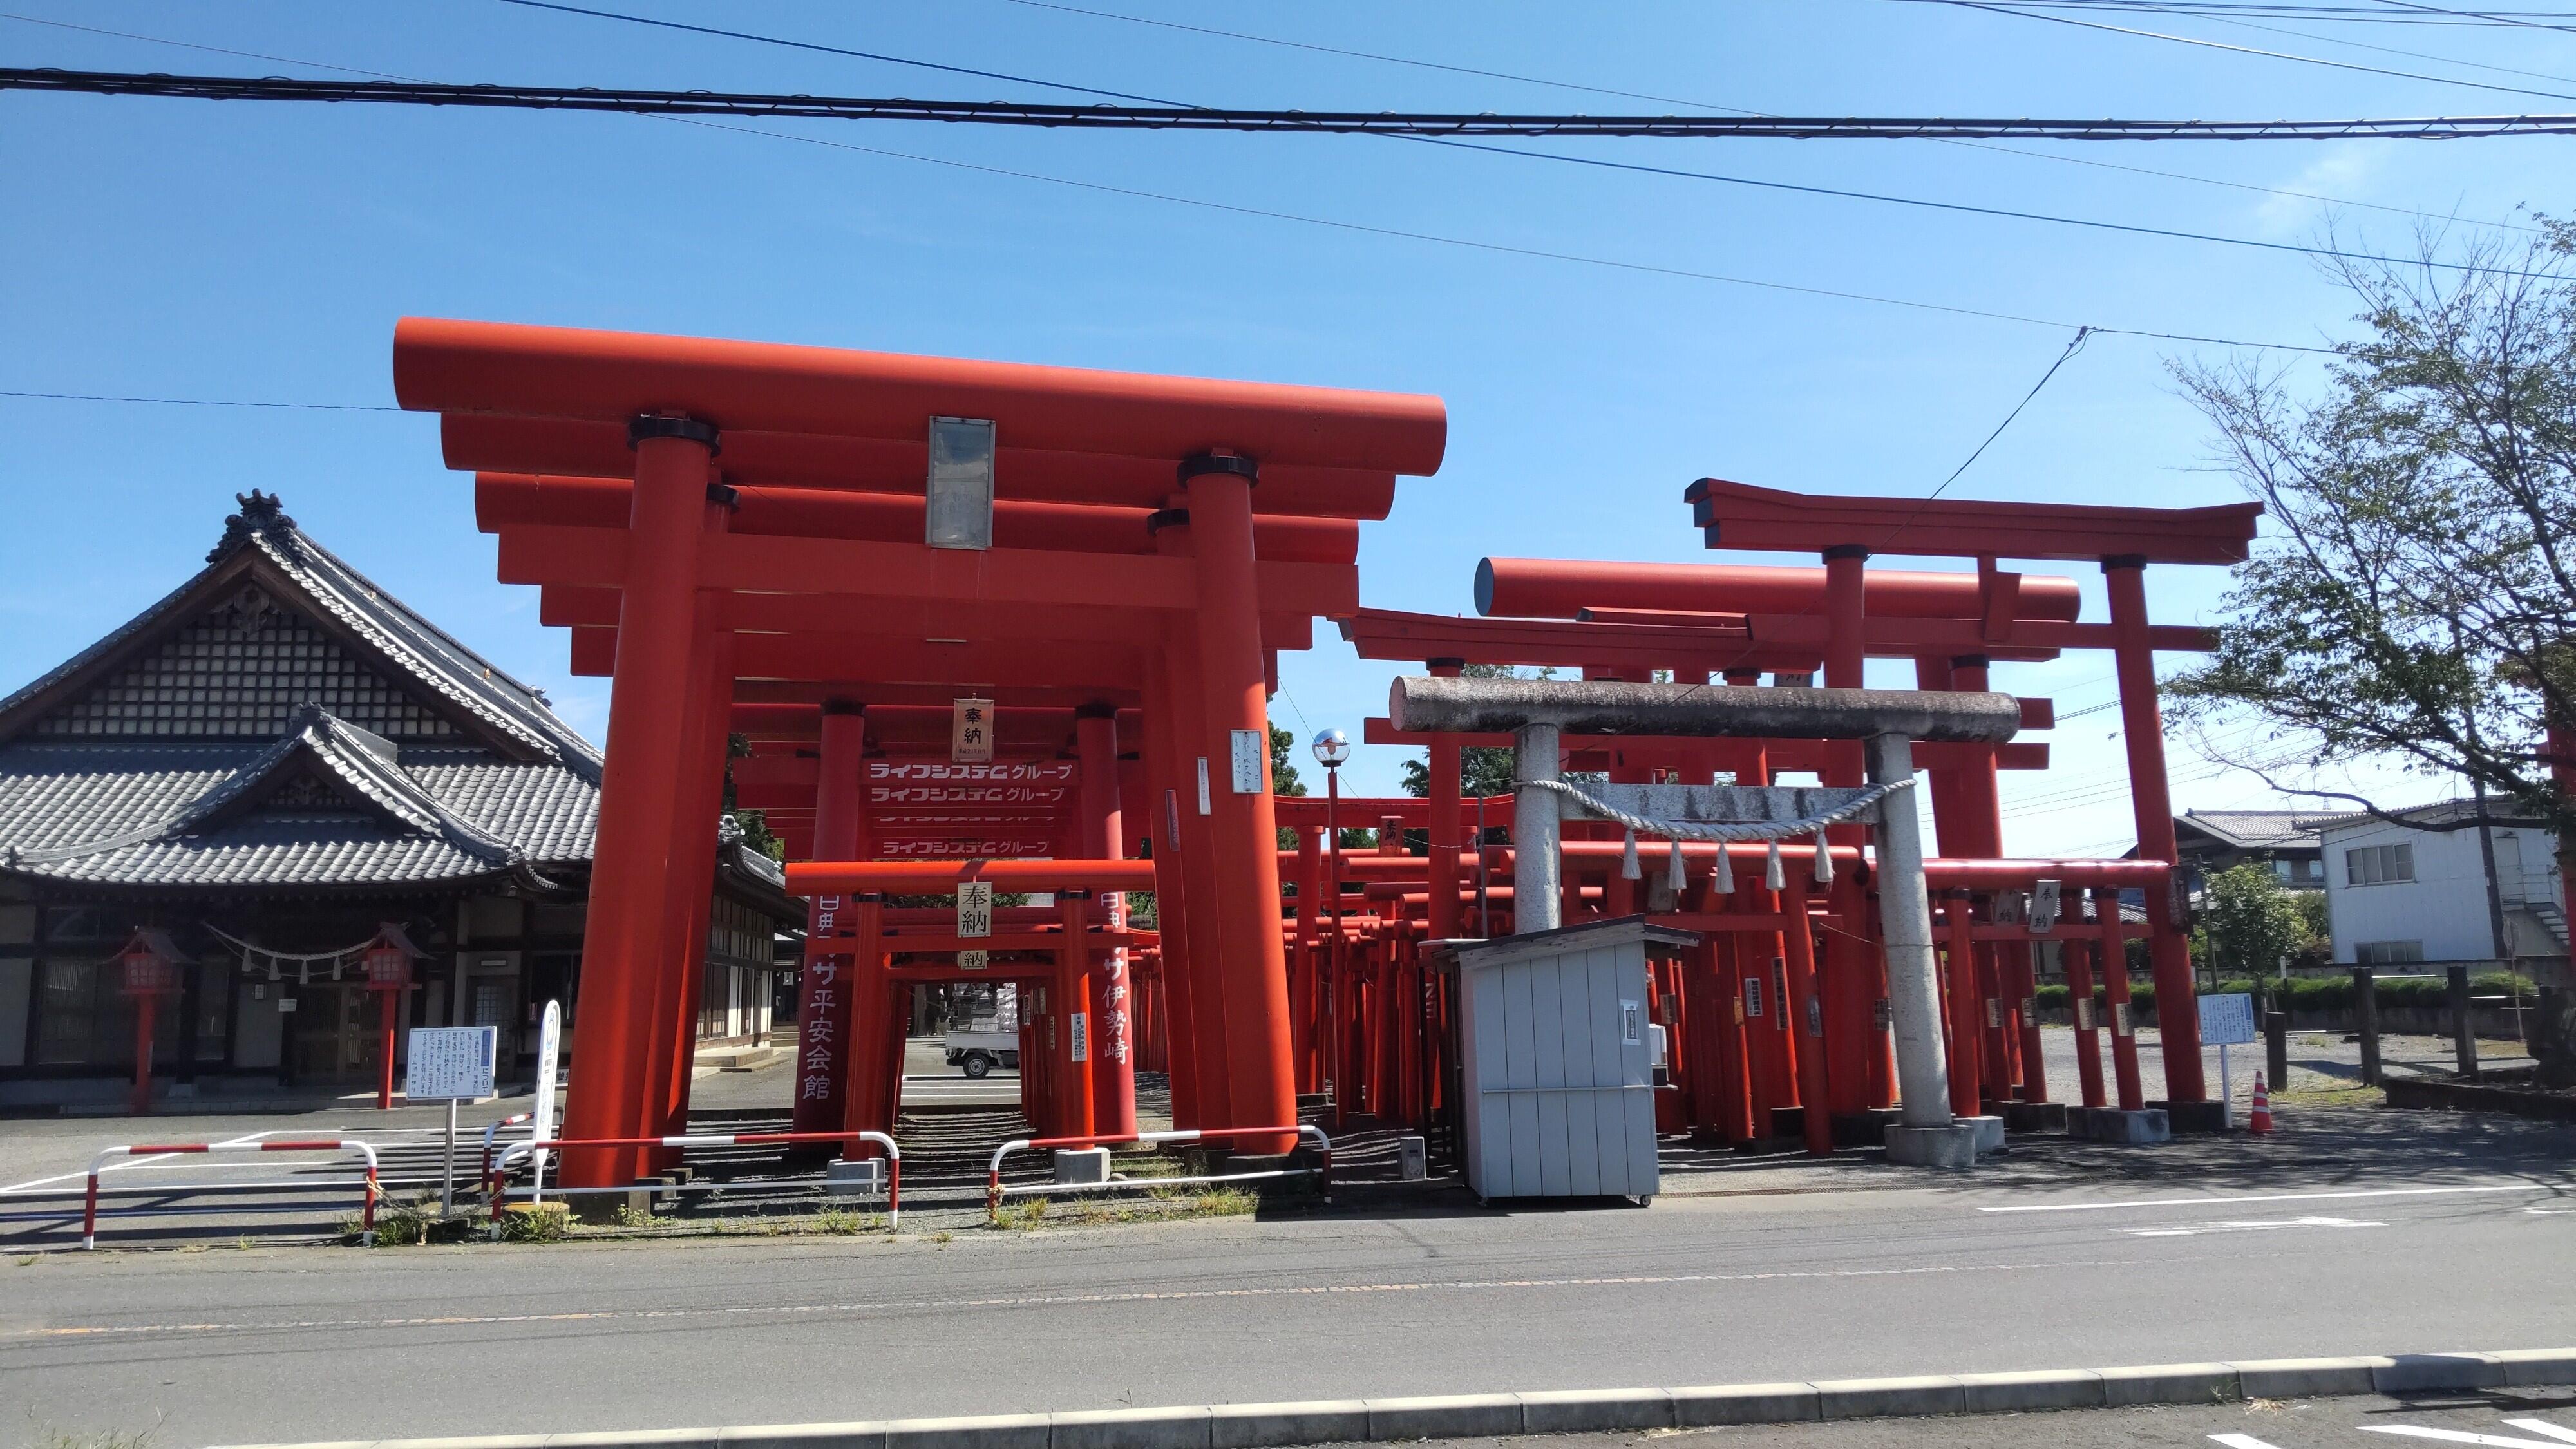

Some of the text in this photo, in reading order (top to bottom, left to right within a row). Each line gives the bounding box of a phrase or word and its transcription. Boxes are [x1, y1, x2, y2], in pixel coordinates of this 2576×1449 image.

[964, 708, 982, 744] 奉納
[961, 886, 988, 933] 奉納
[2034, 886, 2053, 927] 奉納
[1101, 892, 1129, 1065] 日典サ伊勢崎
